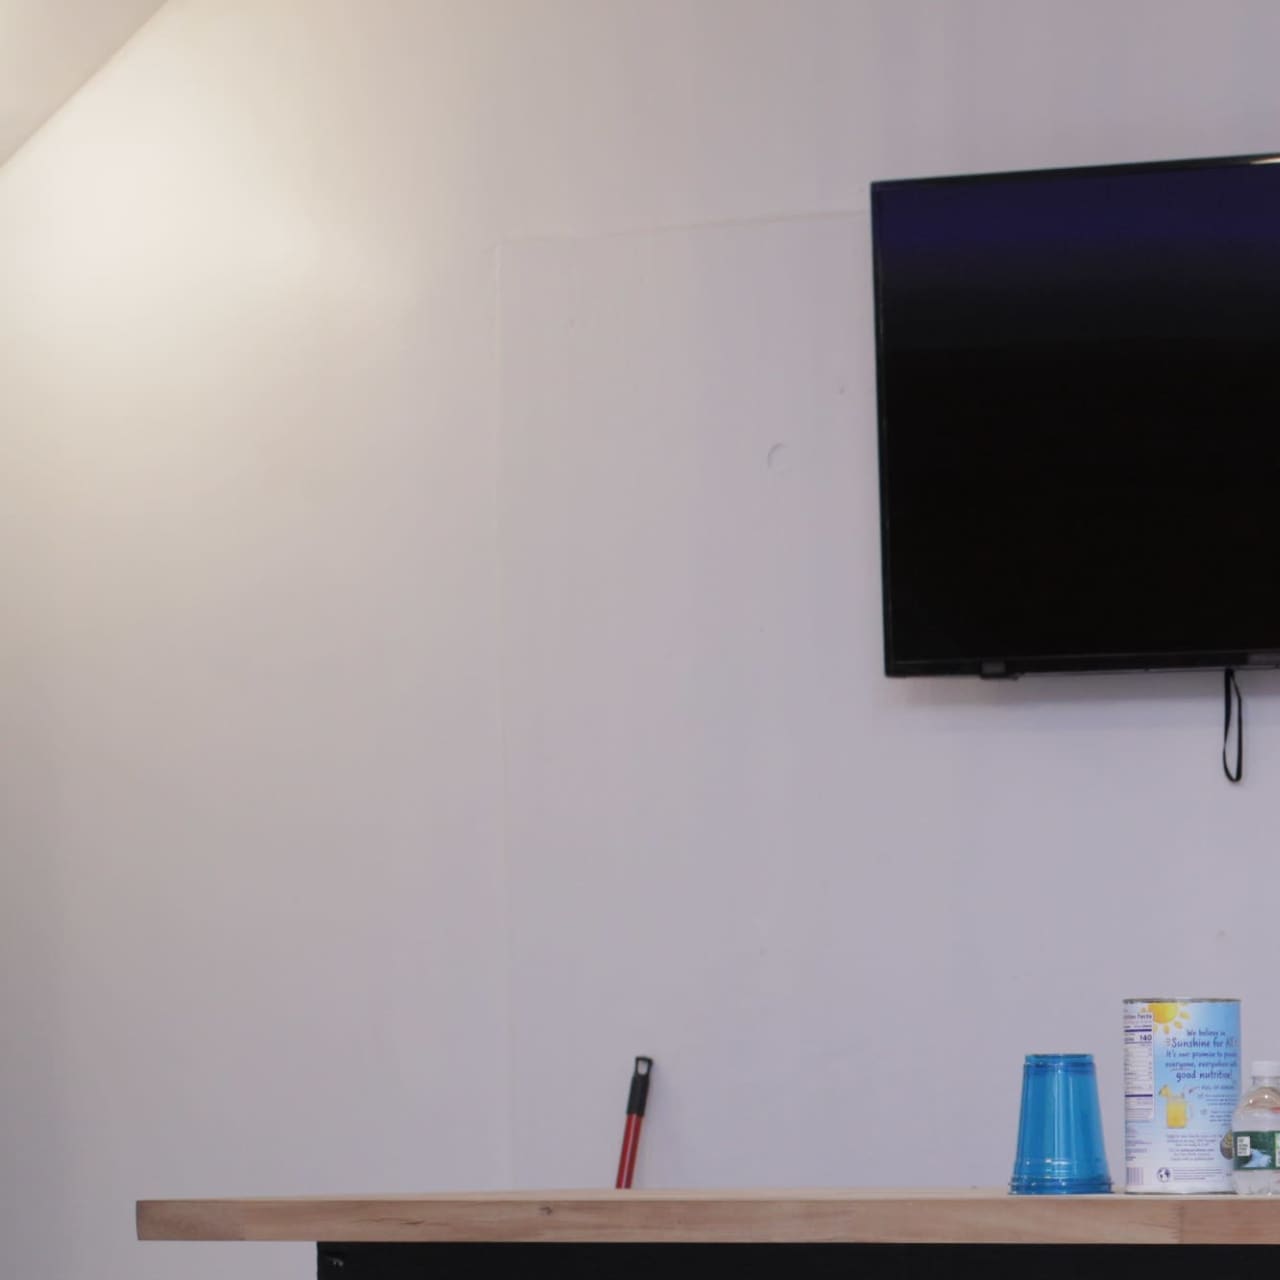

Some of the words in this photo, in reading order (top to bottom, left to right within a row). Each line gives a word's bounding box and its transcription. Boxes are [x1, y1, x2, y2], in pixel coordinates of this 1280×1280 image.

[1171, 1037, 1210, 1049] Sunshine
[1212, 1037, 1223, 1048] for
[1176, 1070, 1197, 1082] good
